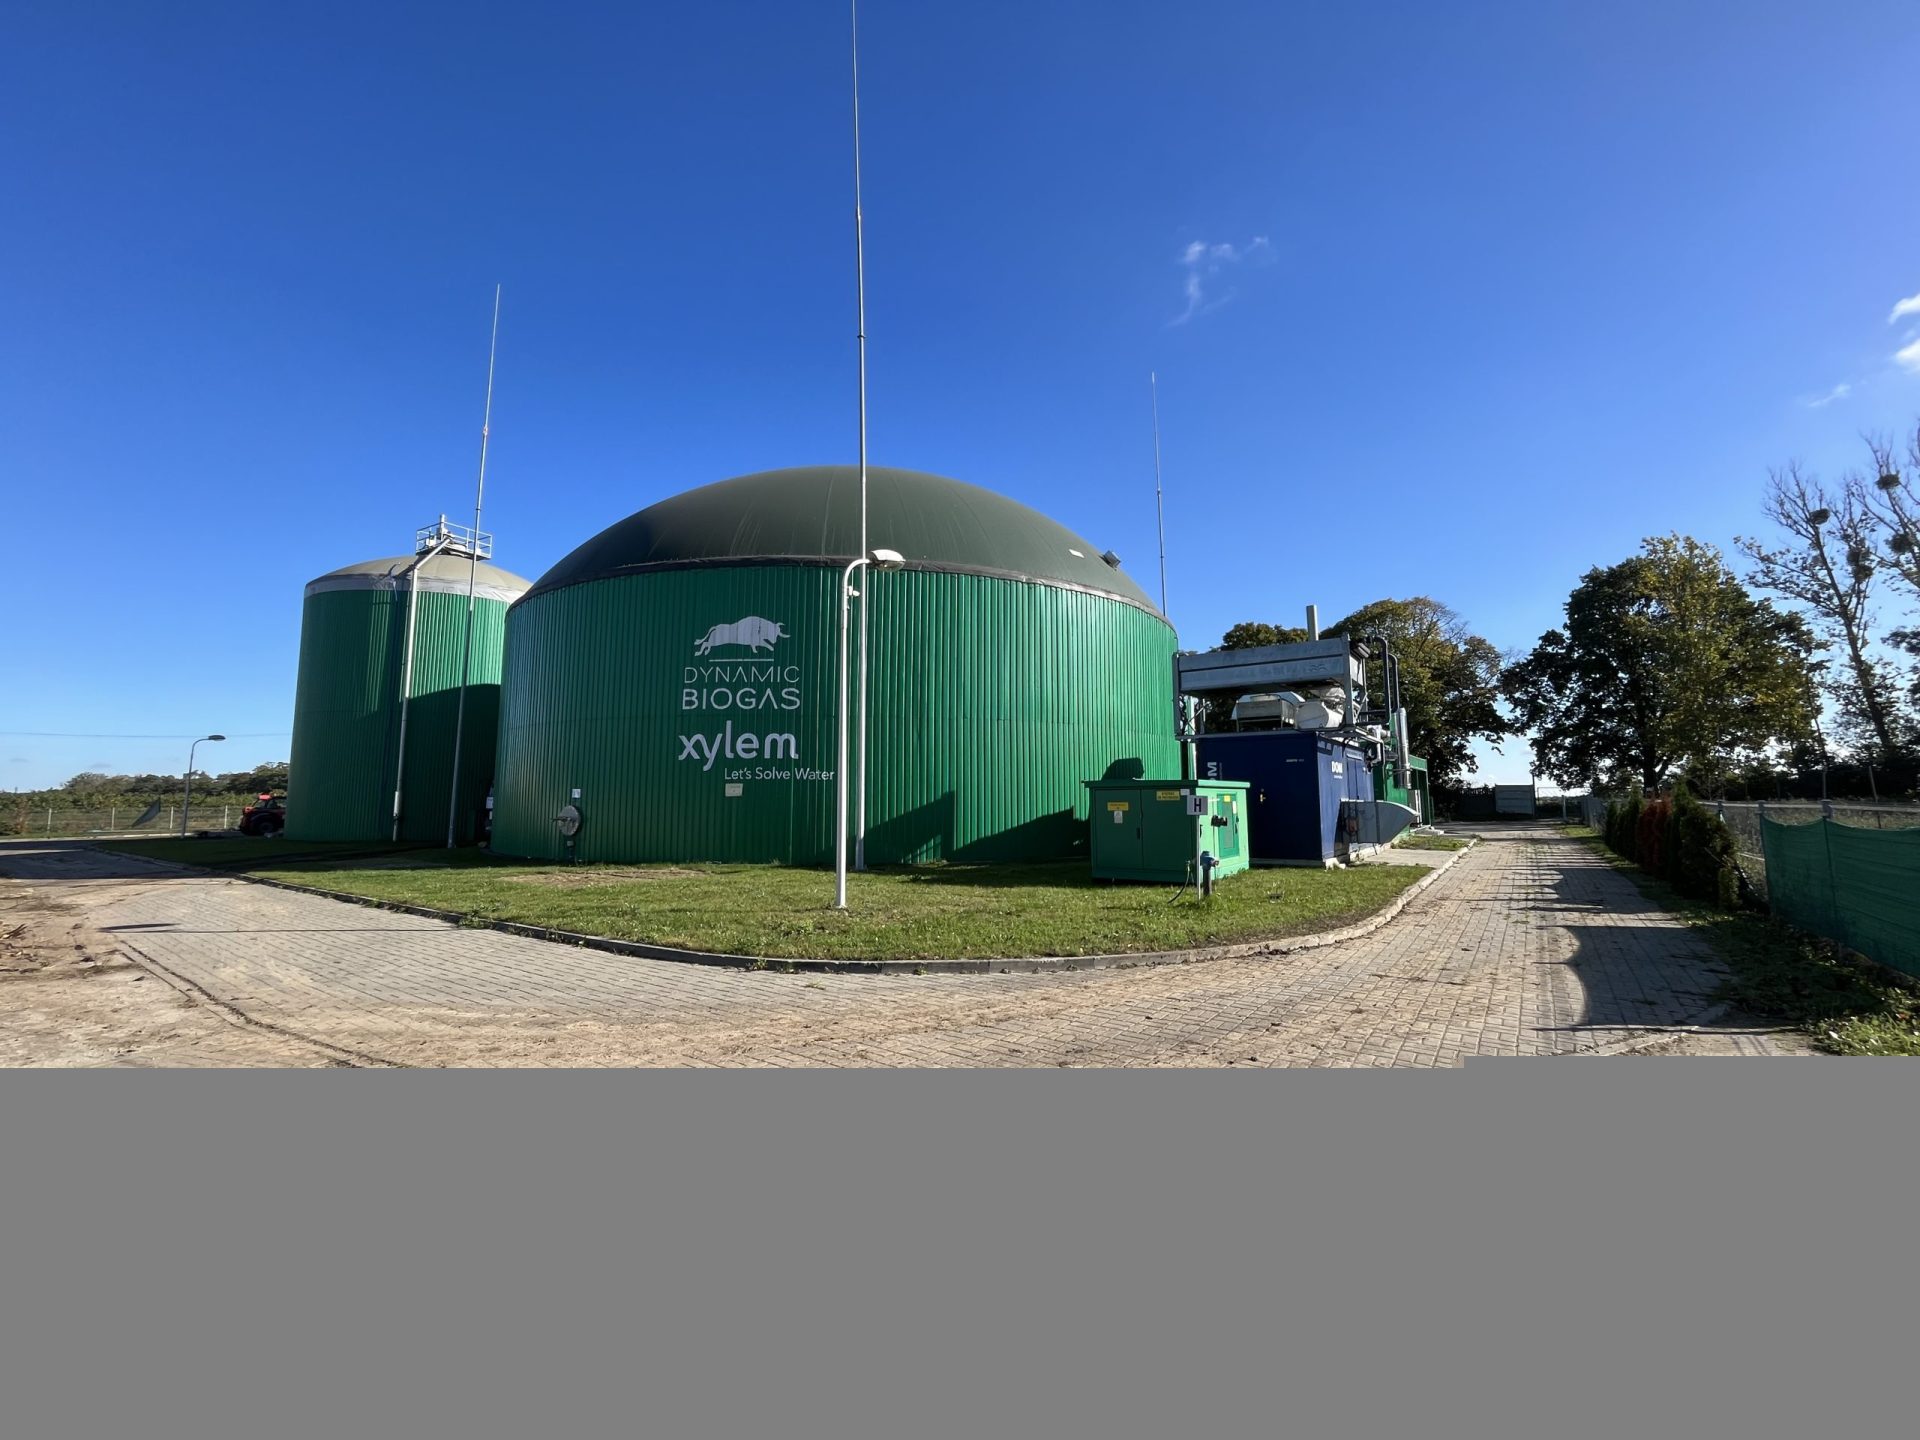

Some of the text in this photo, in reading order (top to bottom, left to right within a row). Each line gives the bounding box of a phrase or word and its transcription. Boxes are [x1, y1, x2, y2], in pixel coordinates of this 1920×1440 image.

[684, 666, 800, 683] DYNAMIC
[682, 688, 800, 710] BIOGAS
[678, 720, 799, 772] xylem
[724, 766, 835, 780] Let's Solve Water
[1193, 797, 1202, 813] H
